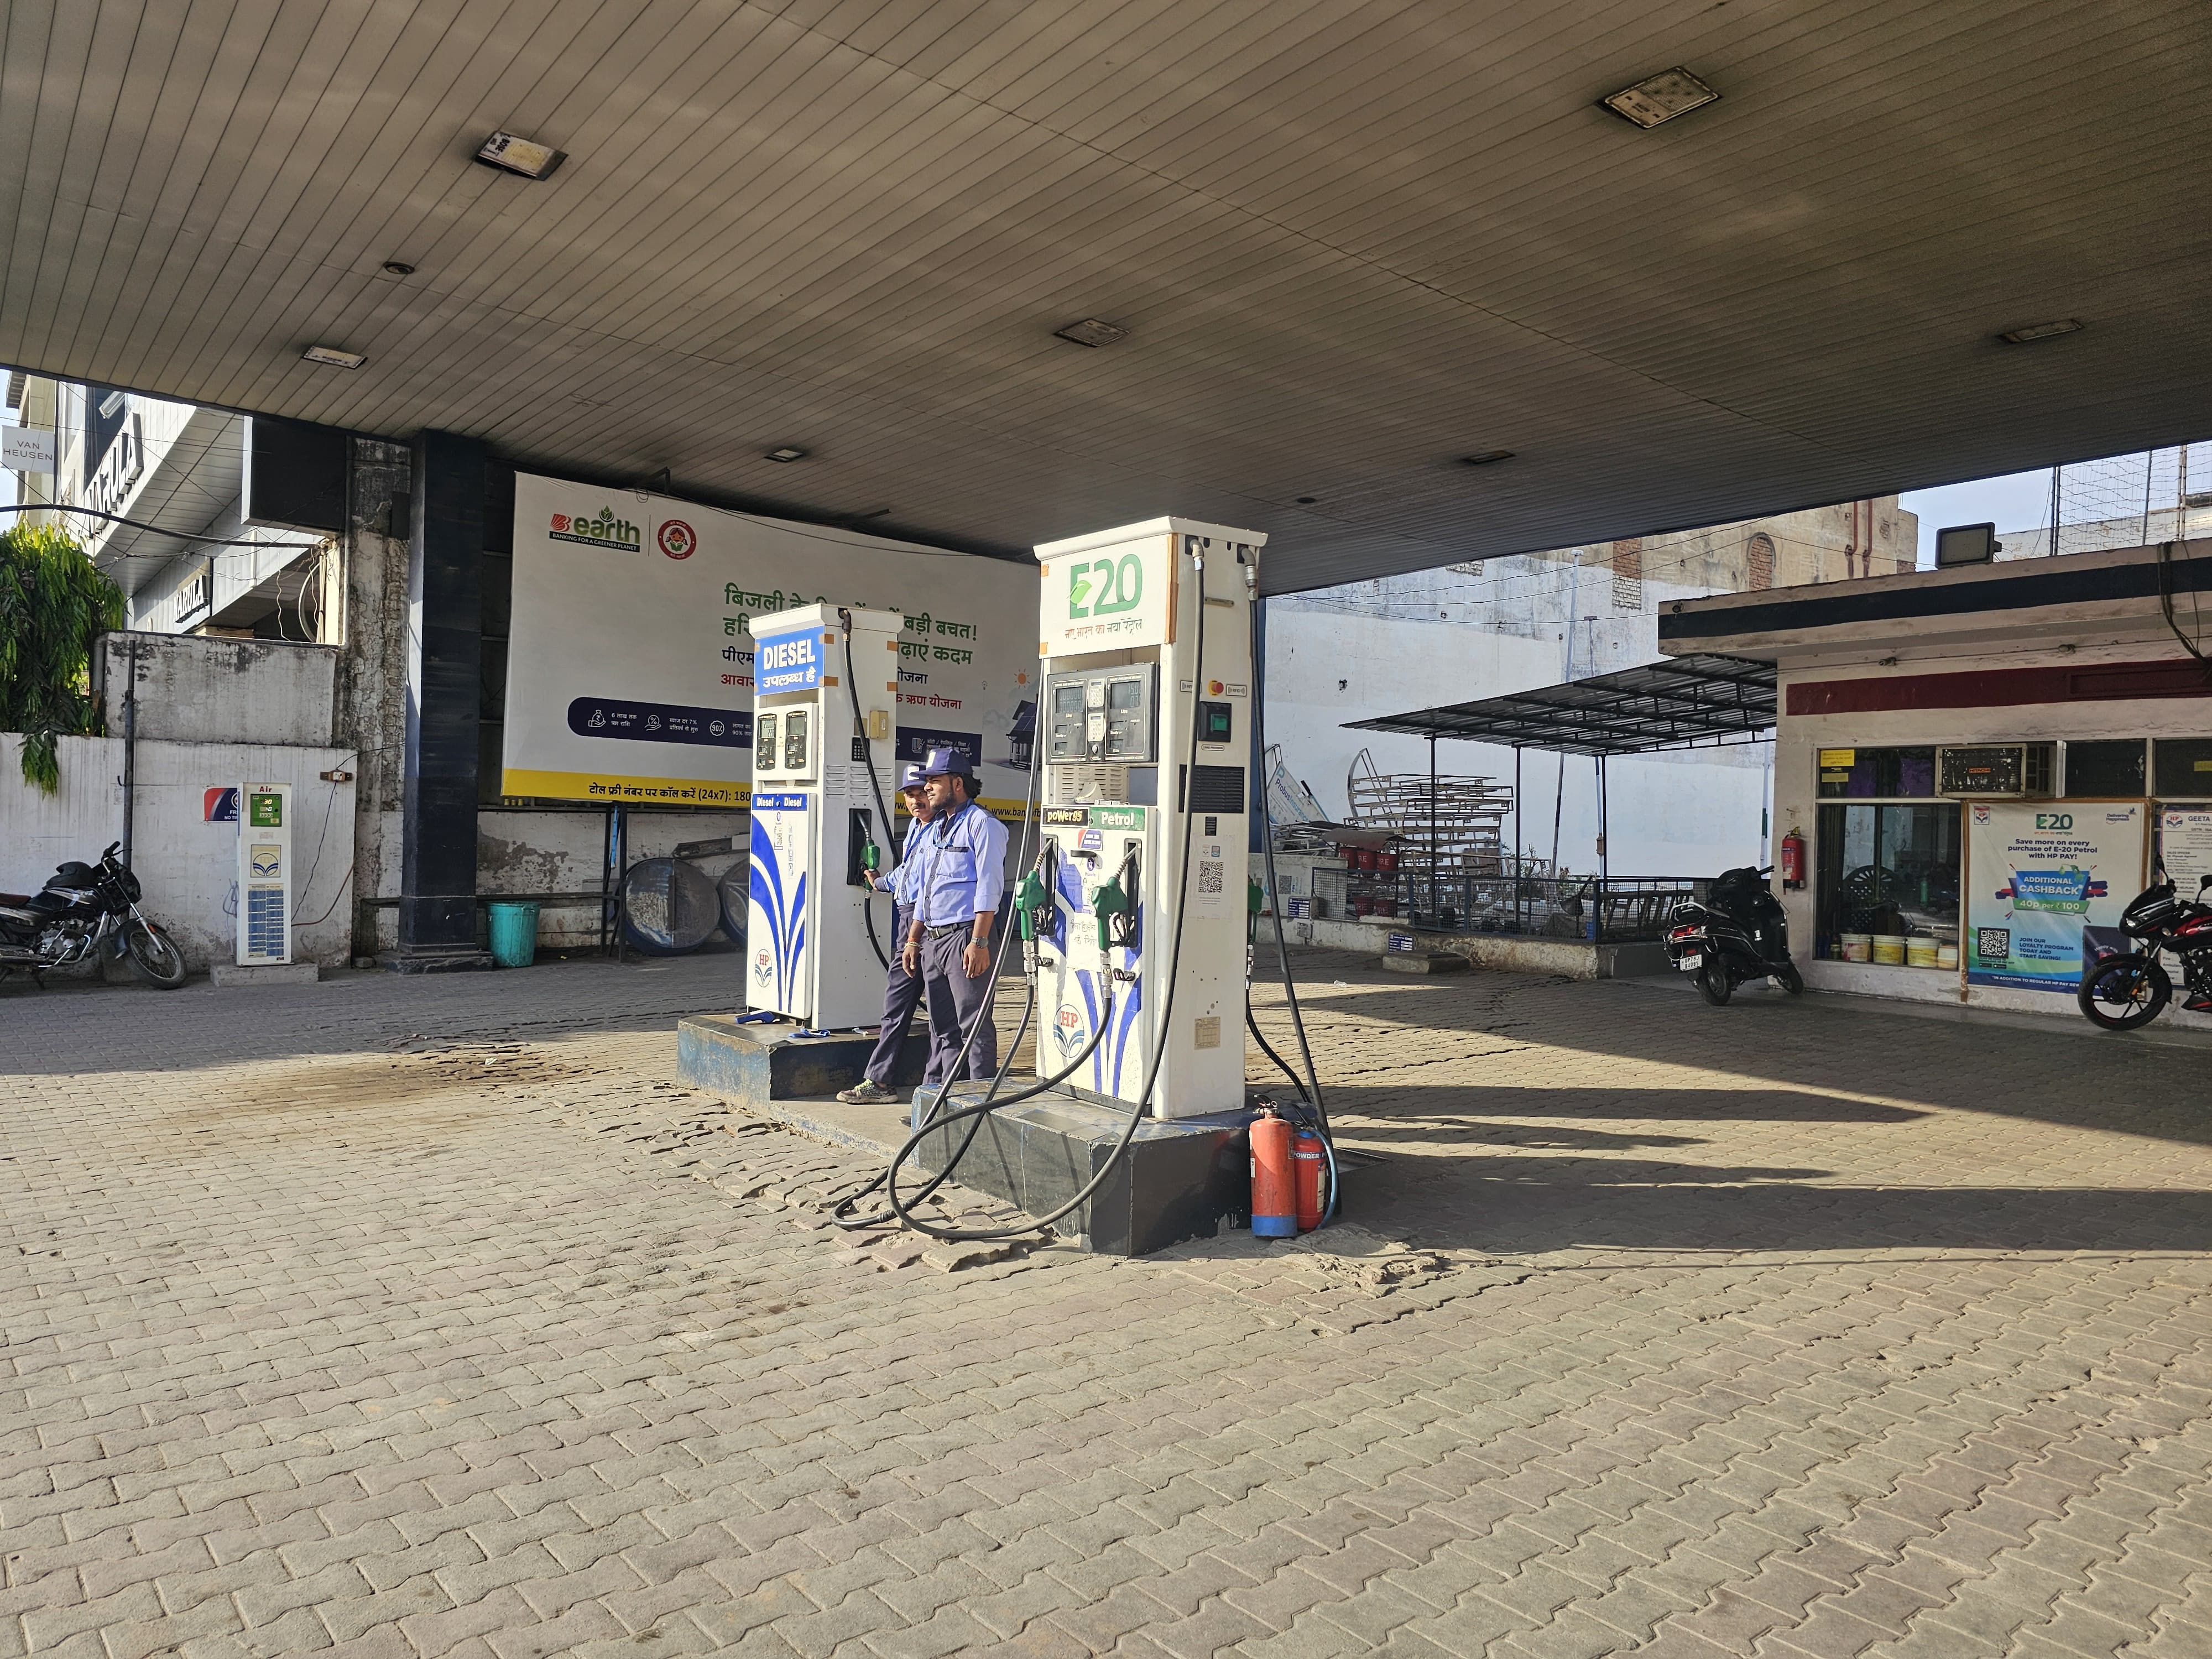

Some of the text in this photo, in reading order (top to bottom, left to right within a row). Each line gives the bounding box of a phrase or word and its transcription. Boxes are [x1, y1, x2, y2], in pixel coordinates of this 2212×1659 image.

[17, 440, 40, 450] VAN
[3, 448, 53, 461] HEUSEN
[574, 517, 640, 545] earth
[553, 533, 577, 541] BANKING
[593, 540, 617, 548] GREENER
[1070, 554, 1142, 619] E20
[173, 575, 209, 623] NARULA
[724, 582, 785, 612] बिजली
[936, 620, 977, 641] बचत!
[1095, 624, 1105, 635] का
[1107, 622, 1121, 633] नया
[764, 639, 816, 670] DIESEL
[933, 646, 973, 665] कदम
[763, 665, 816, 688] उपलब्ध है
[906, 695, 927, 706] ऋण
[929, 694, 962, 709] योजना
[589, 782, 606, 794] टोल
[608, 784, 622, 796] फ्री
[624, 784, 643, 796] नंबर
[645, 788, 658, 797] पर
[660, 787, 679, 797] कॉल
[681, 787, 696, 799] करें
[698, 788, 731, 802] (24x7):
[757, 797, 802, 807] Diesel Diesel
[1101, 812, 1134, 826] Petrol
[2036, 814, 2073, 830] E20
[2020, 900, 2039, 909] 40p
[759, 954, 769, 966] HP
[1061, 1011, 1078, 1028] HP
